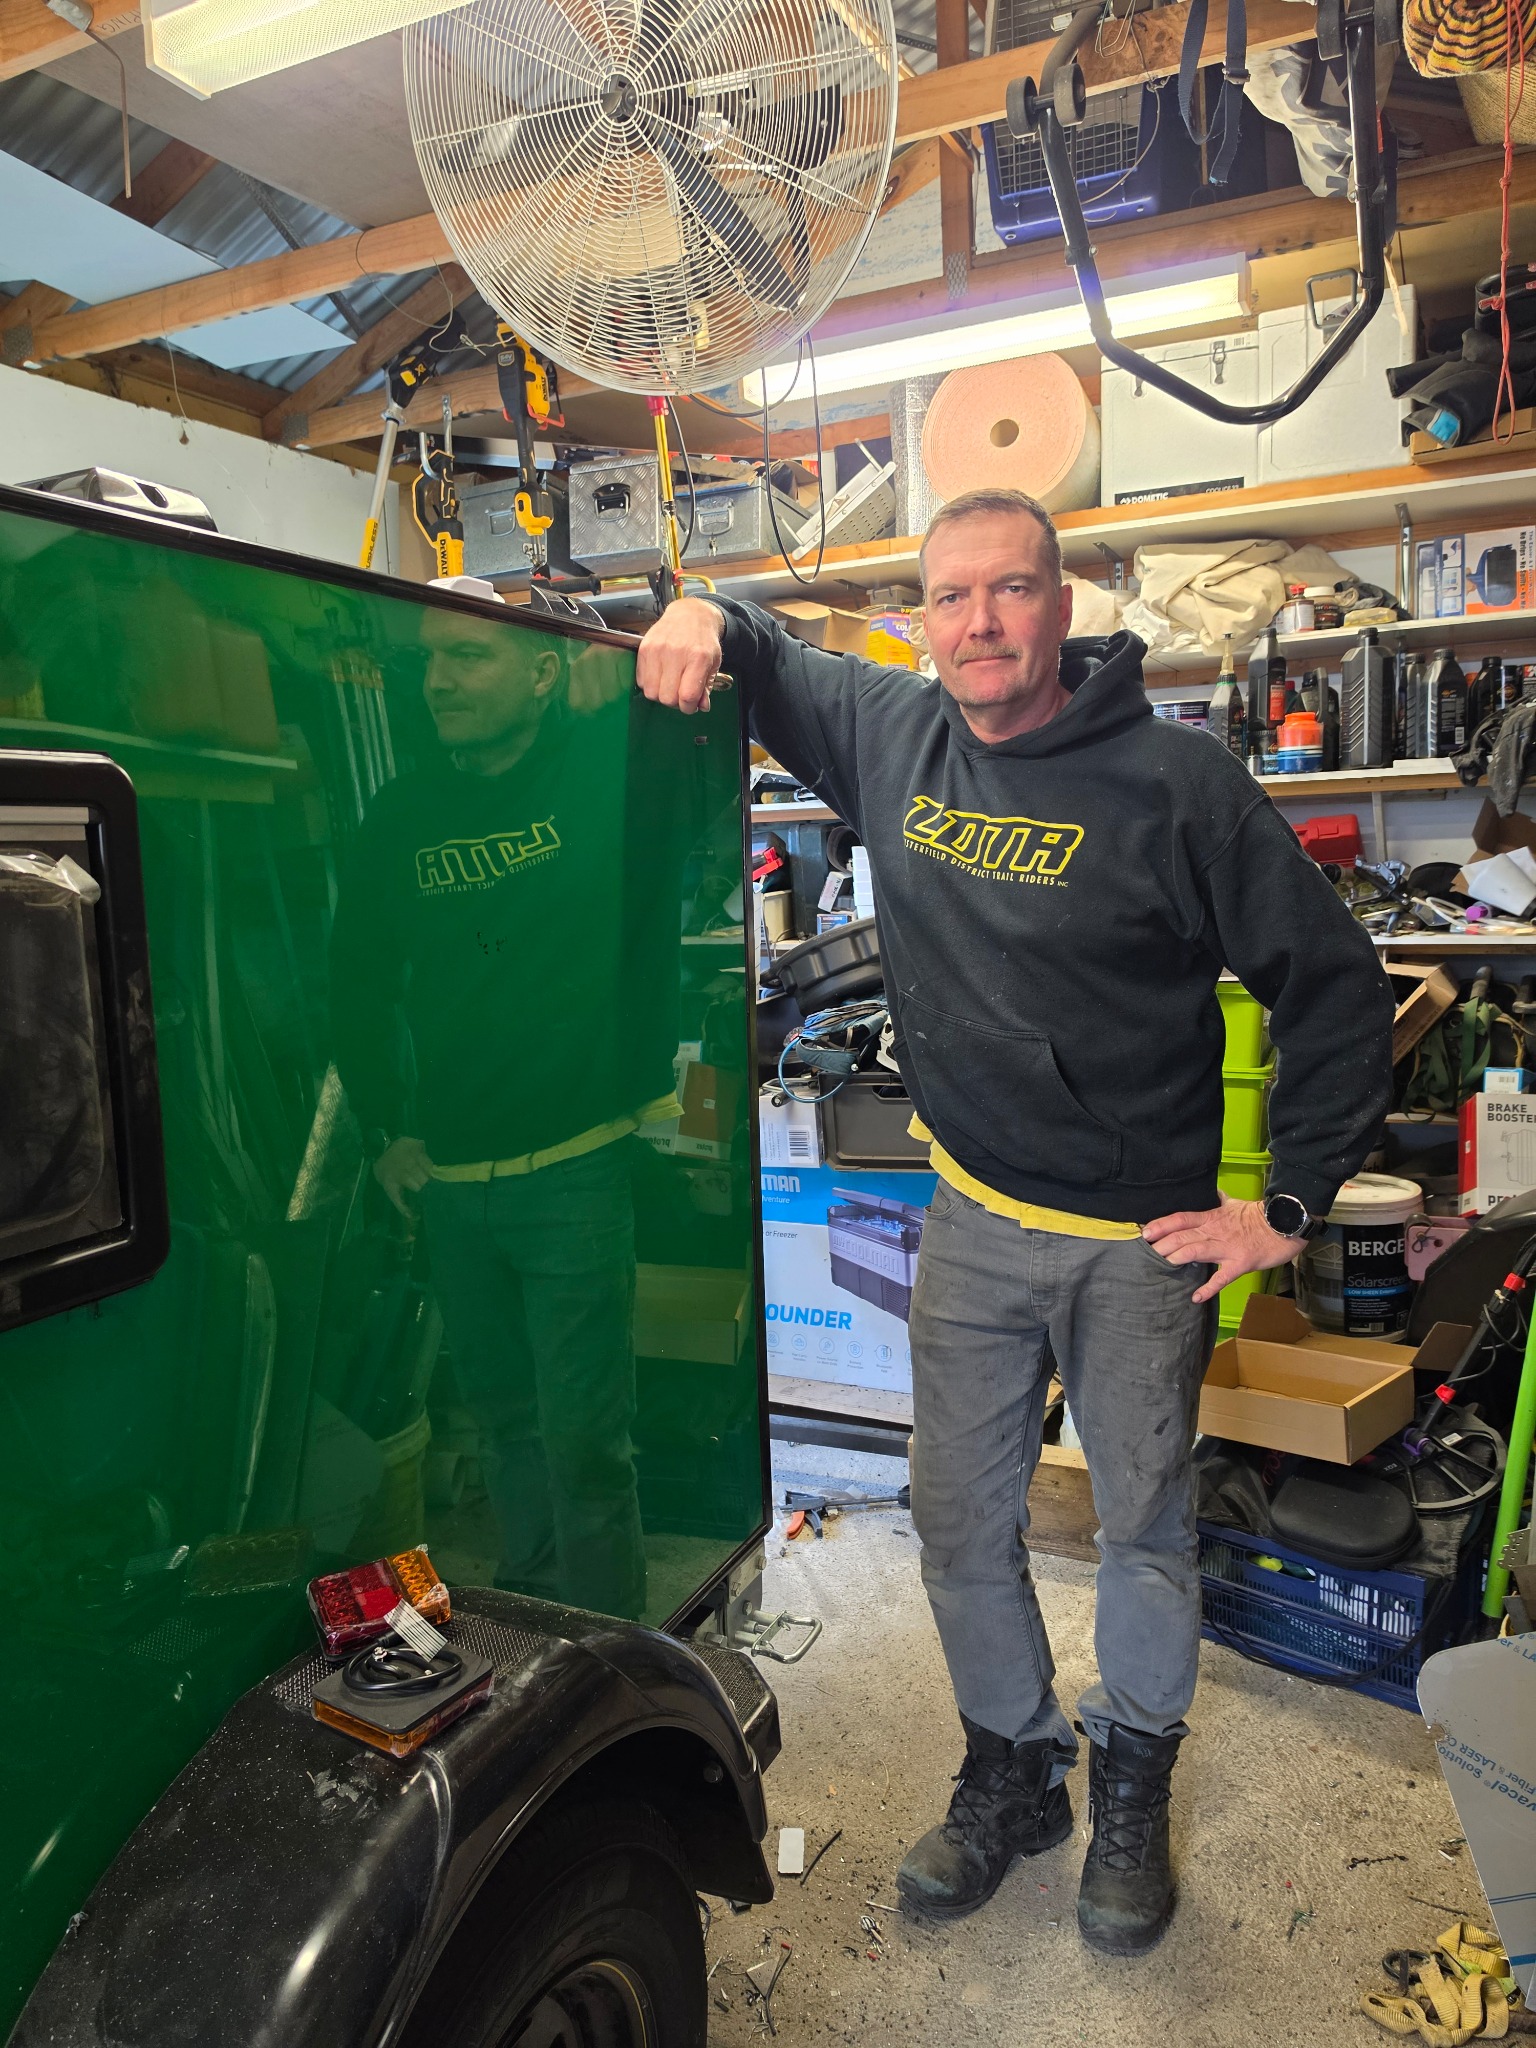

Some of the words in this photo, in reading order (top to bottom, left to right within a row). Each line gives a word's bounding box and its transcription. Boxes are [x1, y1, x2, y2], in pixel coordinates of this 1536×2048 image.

[1131, 491, 1169, 505] DOMETIC
[440, 539, 448, 576] DEWALT
[950, 857, 990, 880] DISTRICT
[992, 870, 1014, 882] TRAIL
[1018, 874, 1055, 887] RIDERS
[1057, 880, 1069, 888] INC
[1487, 1102, 1528, 1114] BRAKE
[772, 1230, 798, 1239] Freezer
[1347, 1238, 1405, 1257] BERGE
[765, 1303, 853, 1331] OUNDER
[1460, 1742, 1497, 1771] LASER
[1498, 1766, 1506, 1775] &
[1505, 1771, 1536, 1796] Fiber
